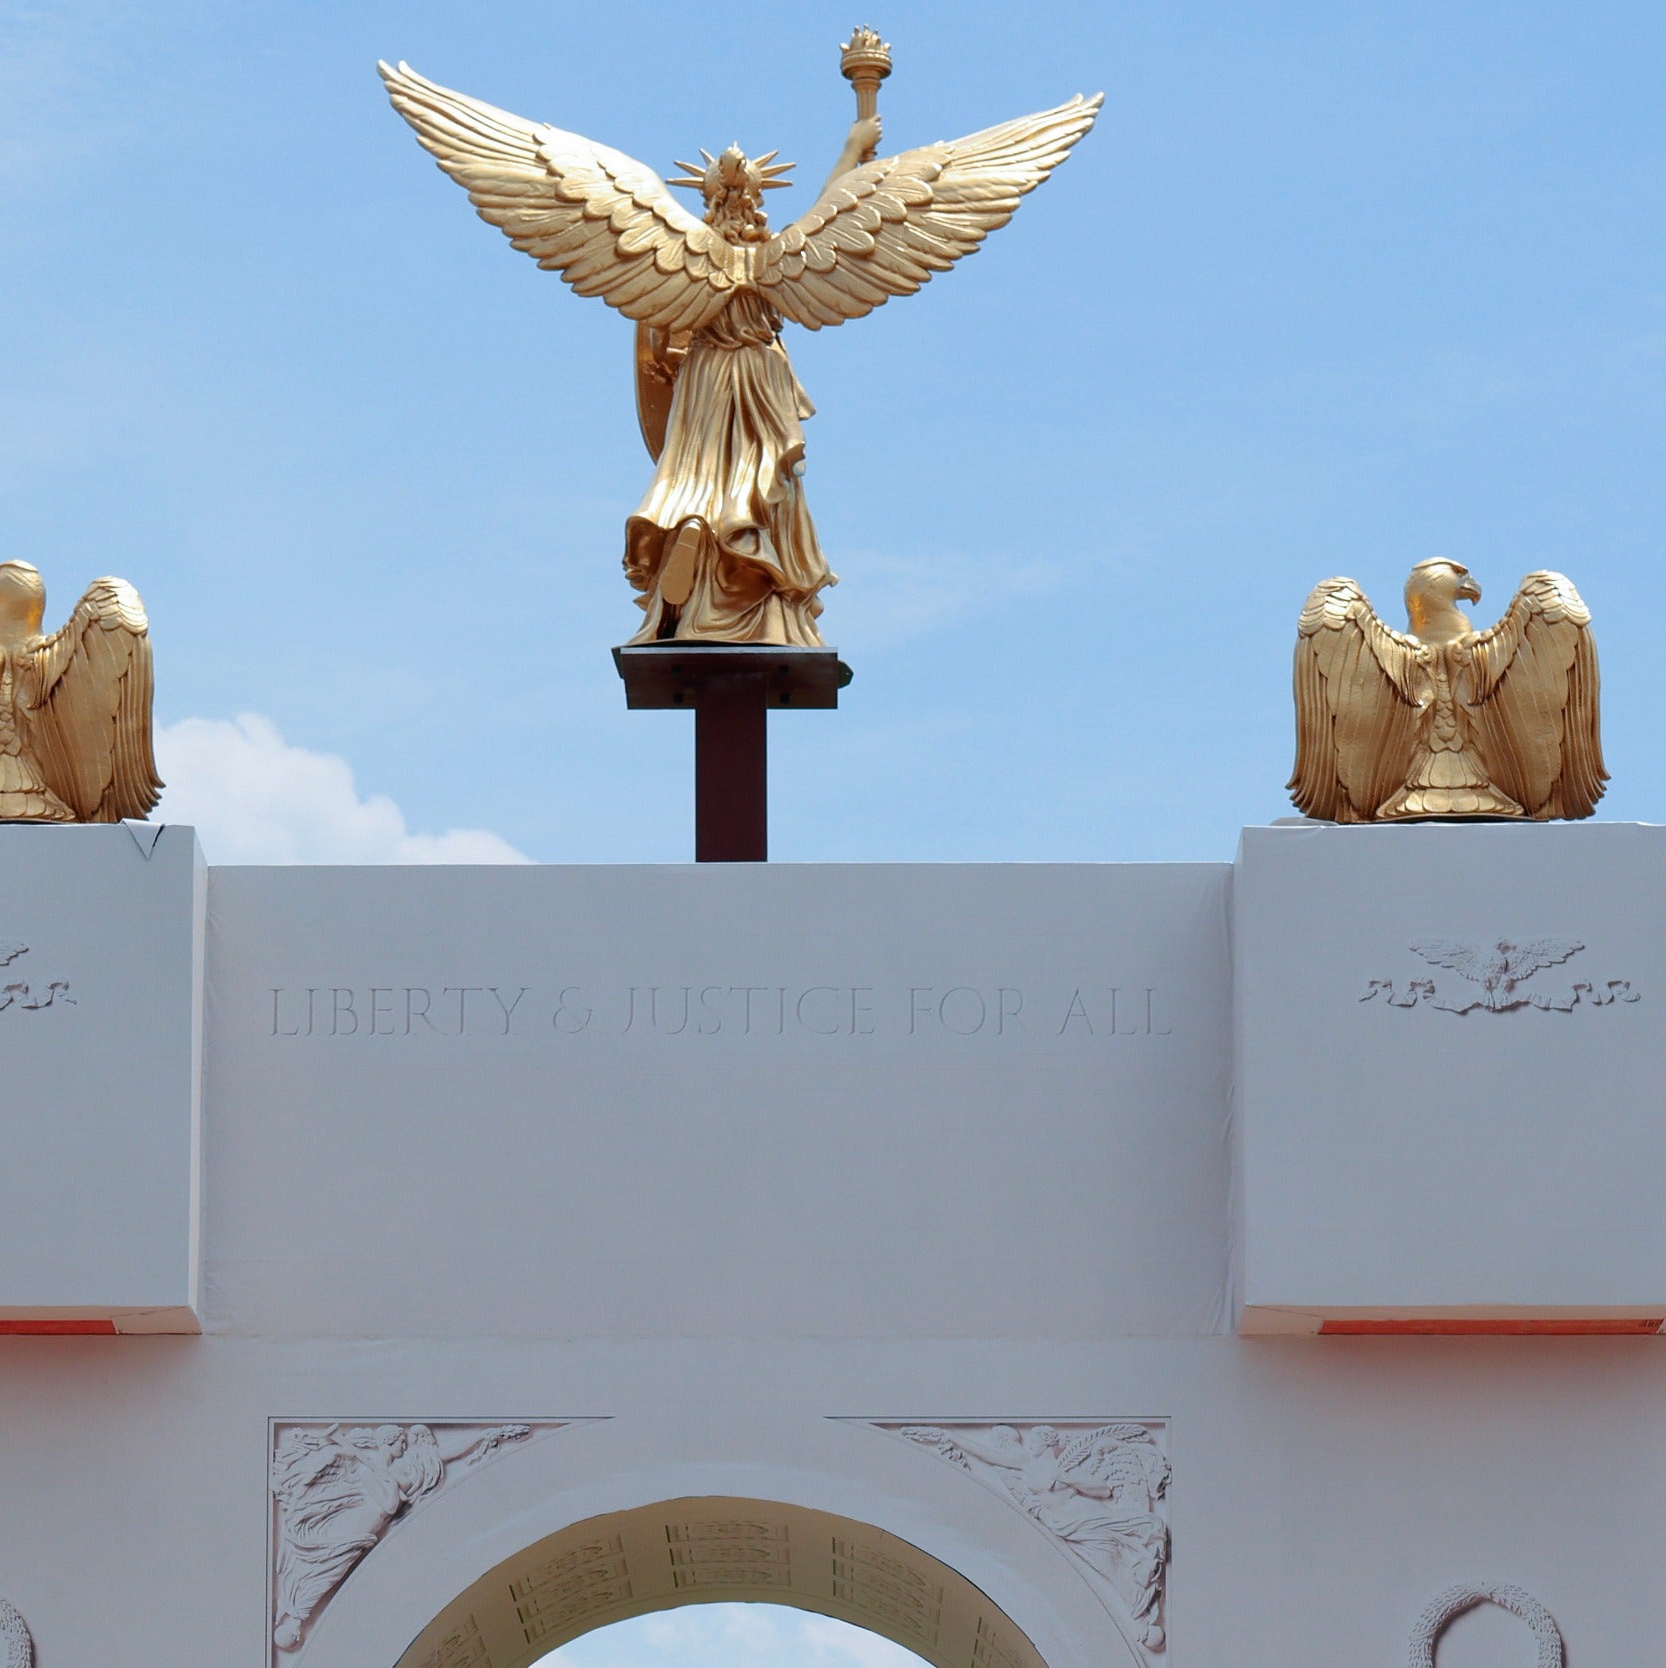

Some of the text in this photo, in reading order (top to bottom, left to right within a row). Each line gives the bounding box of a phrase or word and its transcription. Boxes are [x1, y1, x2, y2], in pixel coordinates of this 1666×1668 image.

[269, 986, 1173, 1037] LIBERTY & JUSTICE FOR ALL
